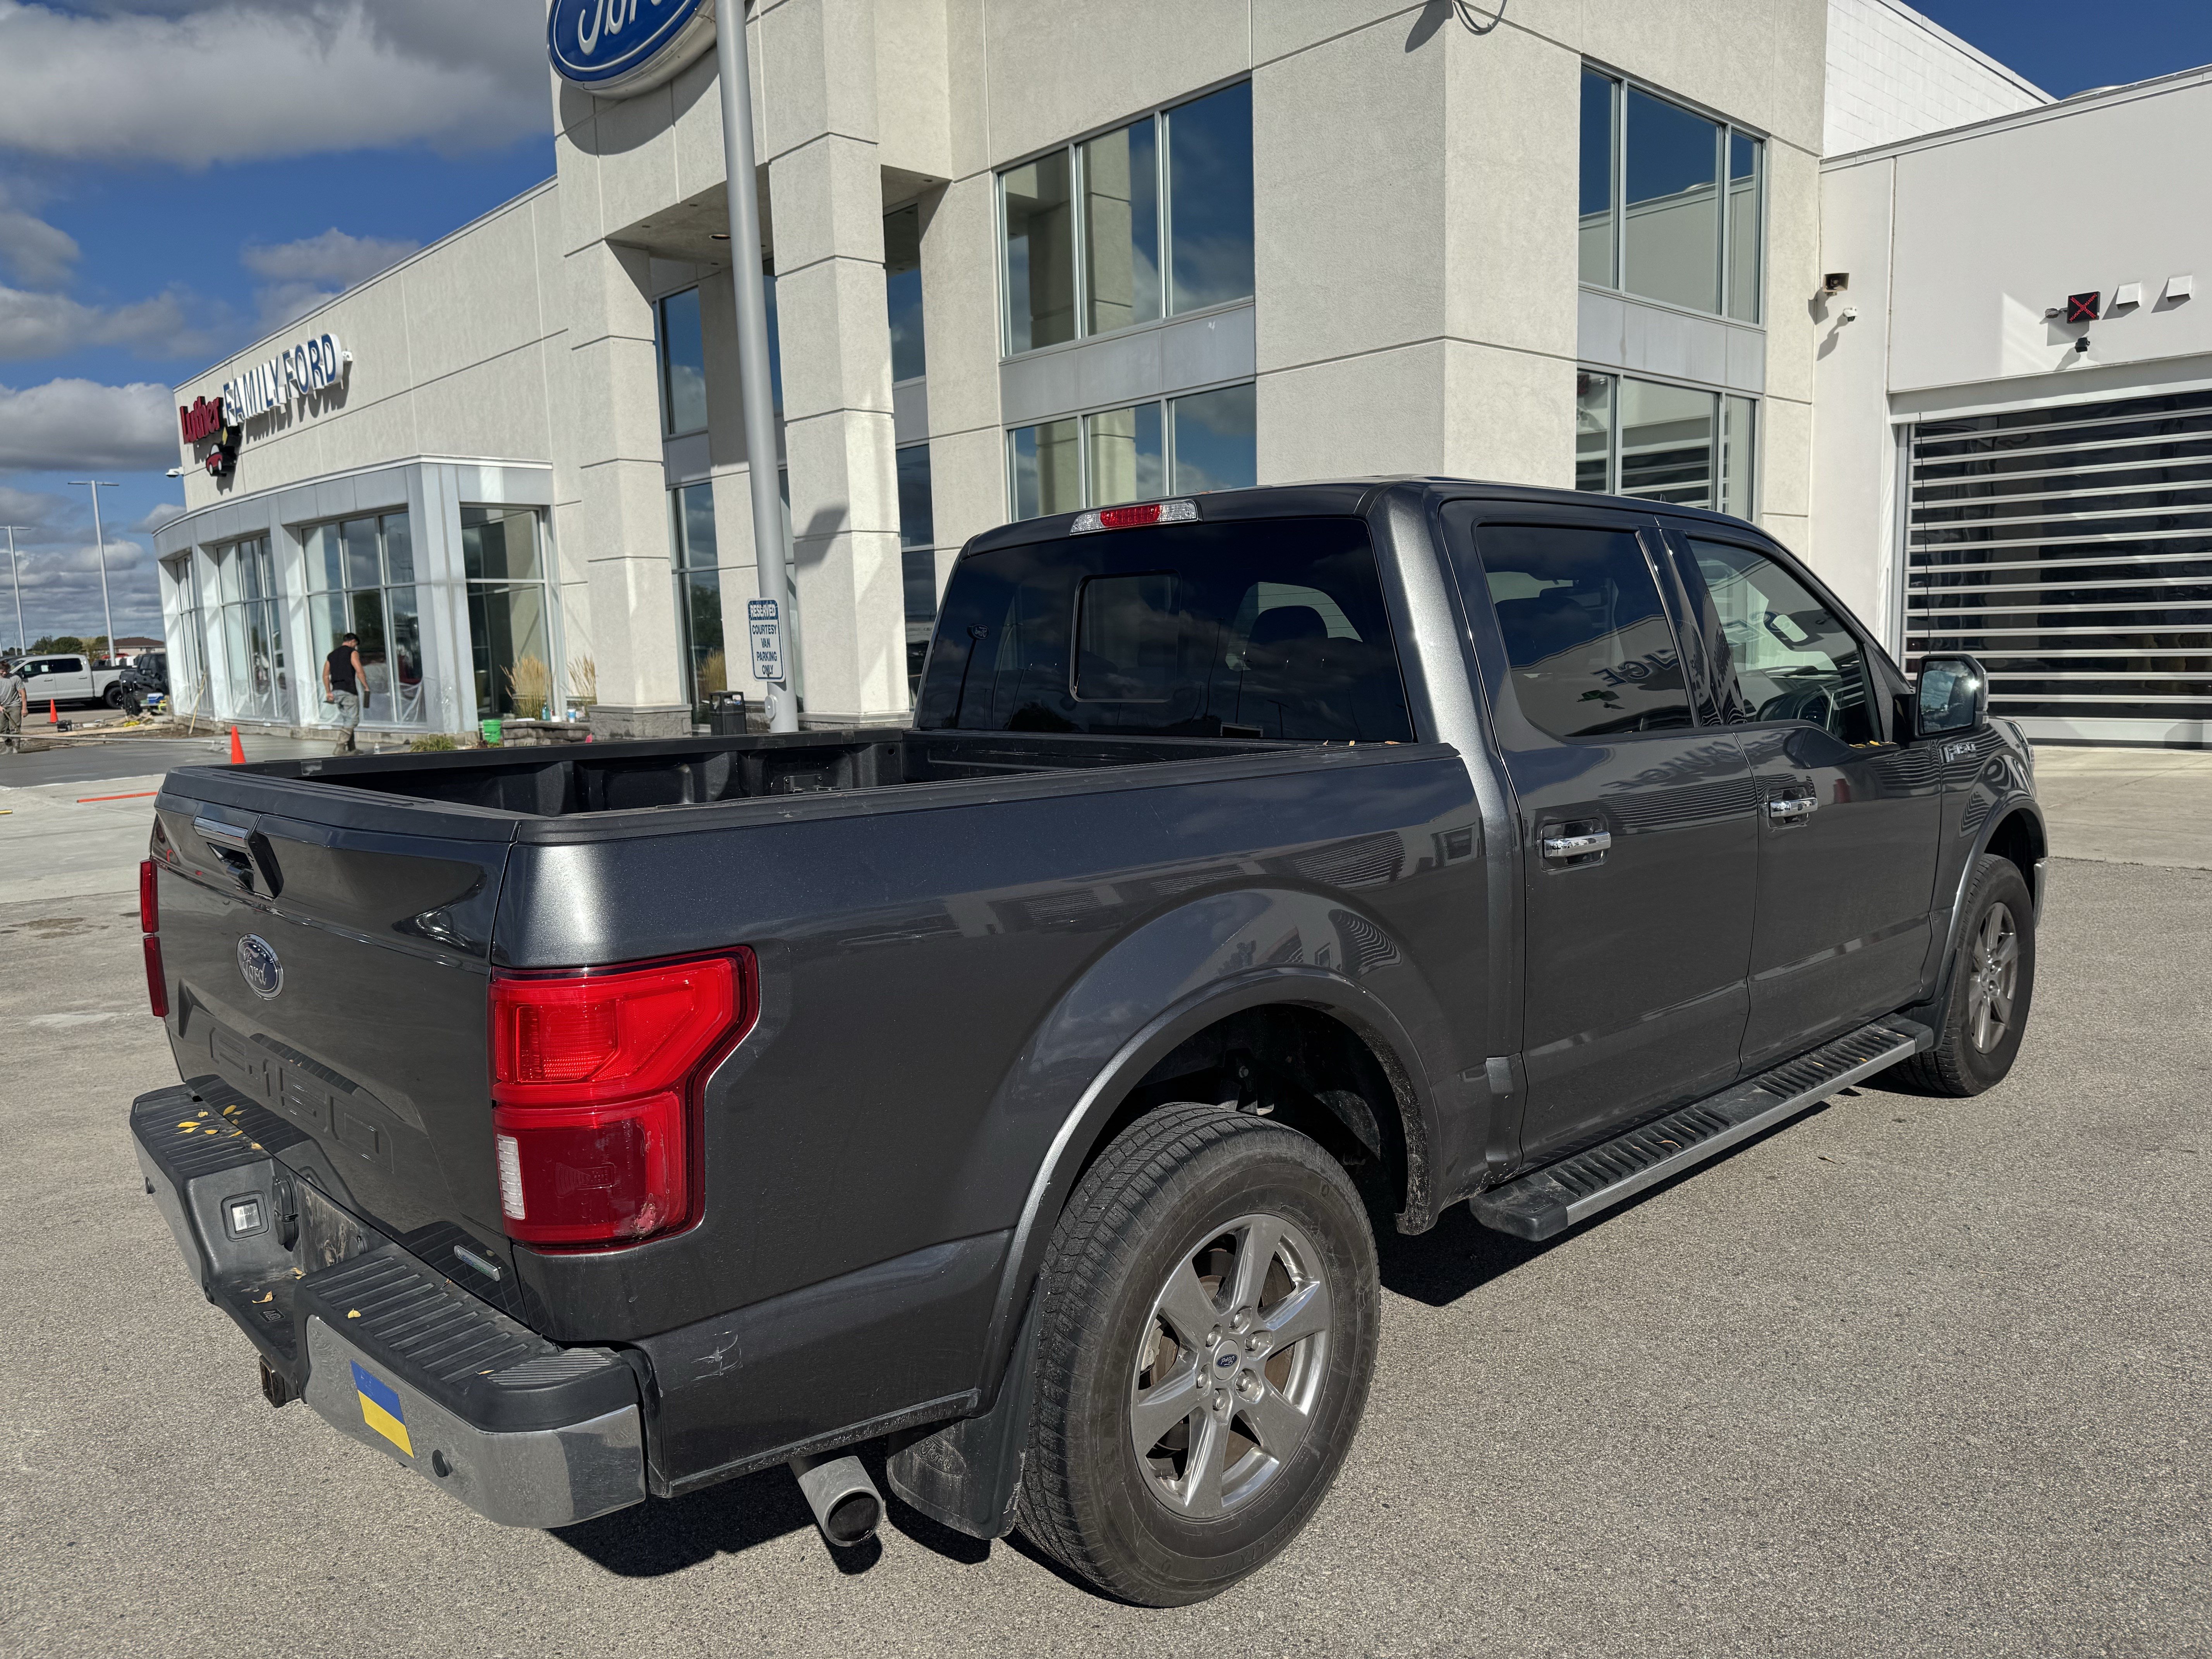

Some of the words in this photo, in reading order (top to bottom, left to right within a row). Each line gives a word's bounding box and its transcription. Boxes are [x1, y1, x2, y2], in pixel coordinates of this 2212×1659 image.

[180, 396, 223, 445] Luther
[223, 356, 287, 426] FAMILY
[282, 333, 342, 399] FORD
[750, 604, 776, 617] RESERVED
[752, 624, 777, 635] COURTESY
[760, 637, 771, 648] VAN
[756, 651, 777, 661] PARKING
[762, 665, 773, 675] ONLY
[242, 947, 267, 986] Ford
[1220, 1355, 1235, 1366] Ford
[921, 1437, 953, 1470] Ford
[1271, 1463, 1331, 1546] DEFENDER
[1239, 1541, 1266, 1565] LTX
